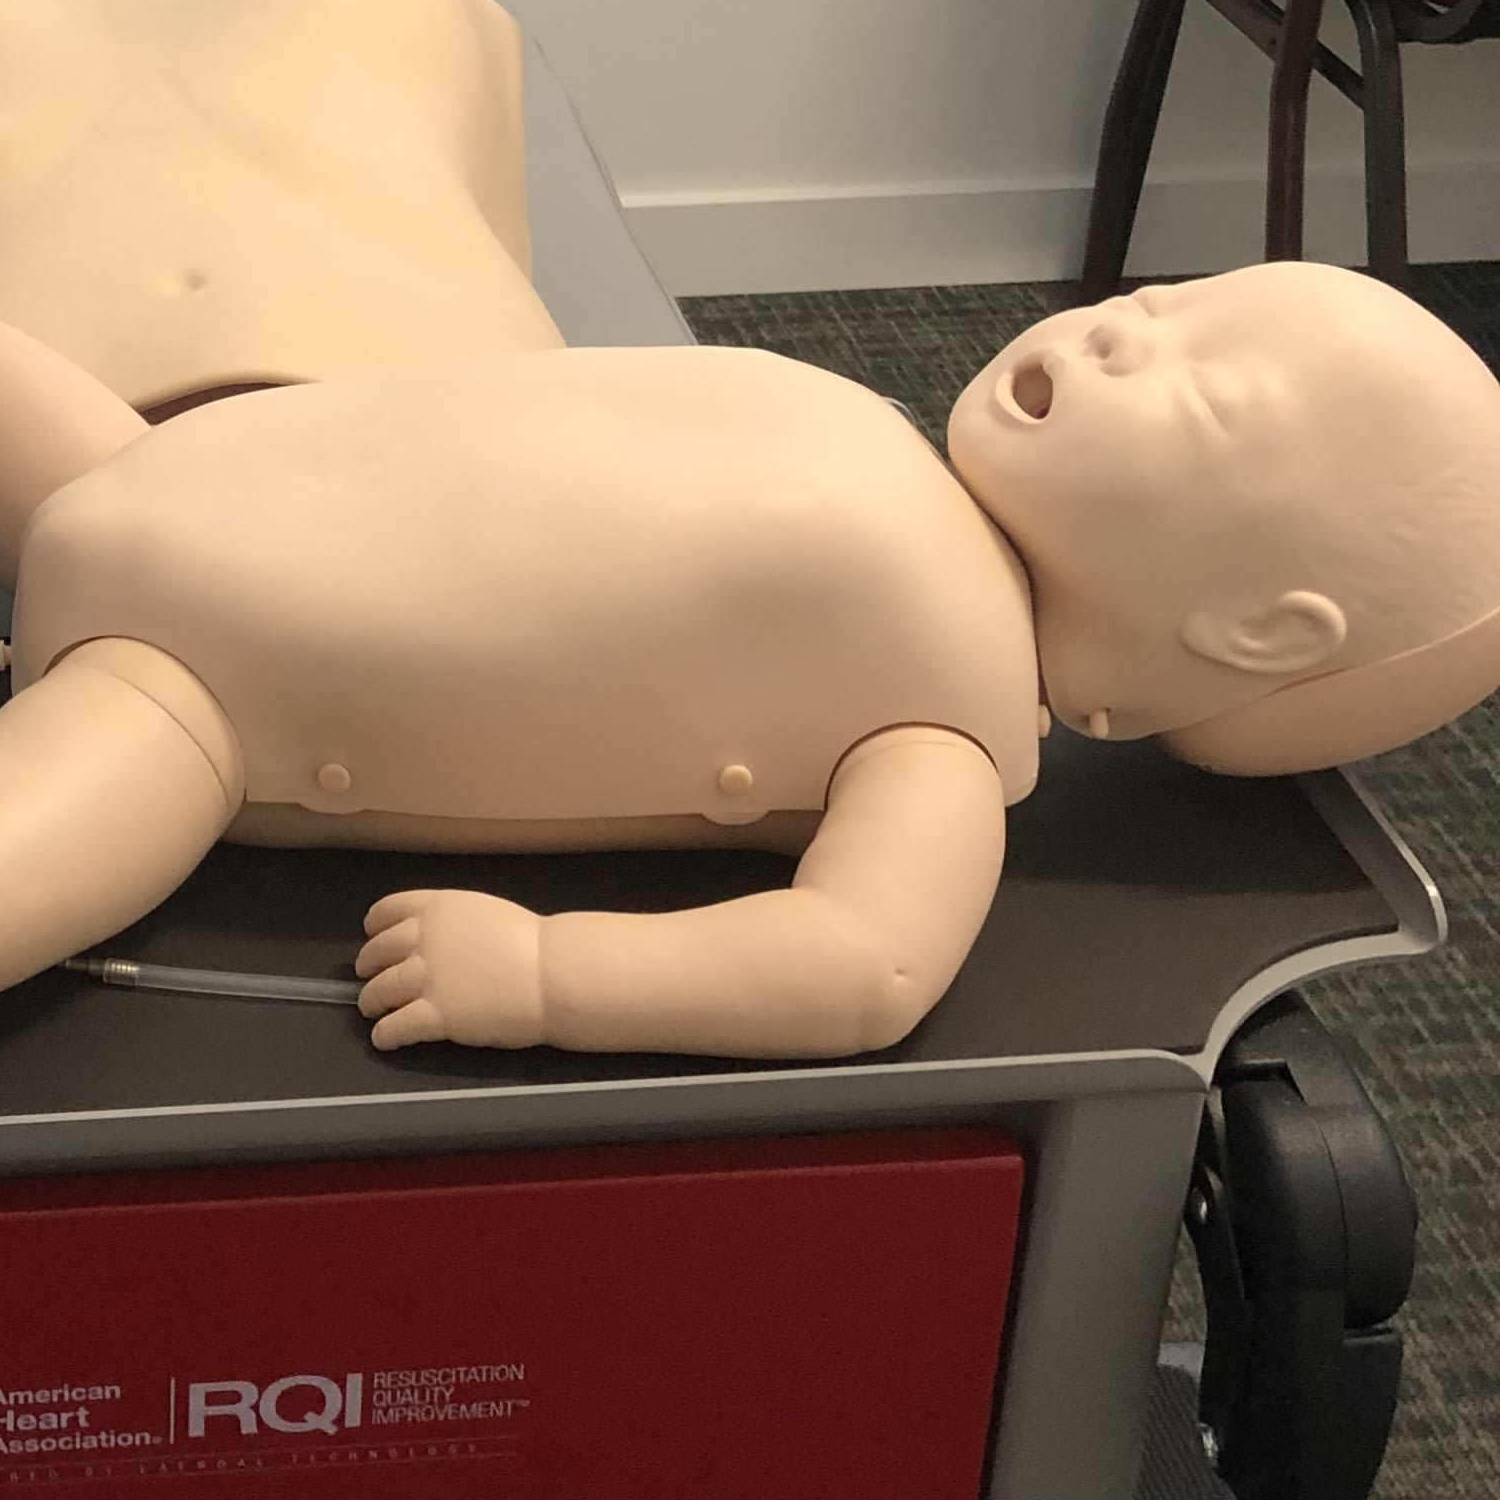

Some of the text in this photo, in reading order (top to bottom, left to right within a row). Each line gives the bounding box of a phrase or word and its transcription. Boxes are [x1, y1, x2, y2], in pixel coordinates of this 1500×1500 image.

[373, 1363, 525, 1389] RESUSCITATION
[188, 1373, 364, 1438] RQI
[372, 1387, 454, 1407] QUALITY
